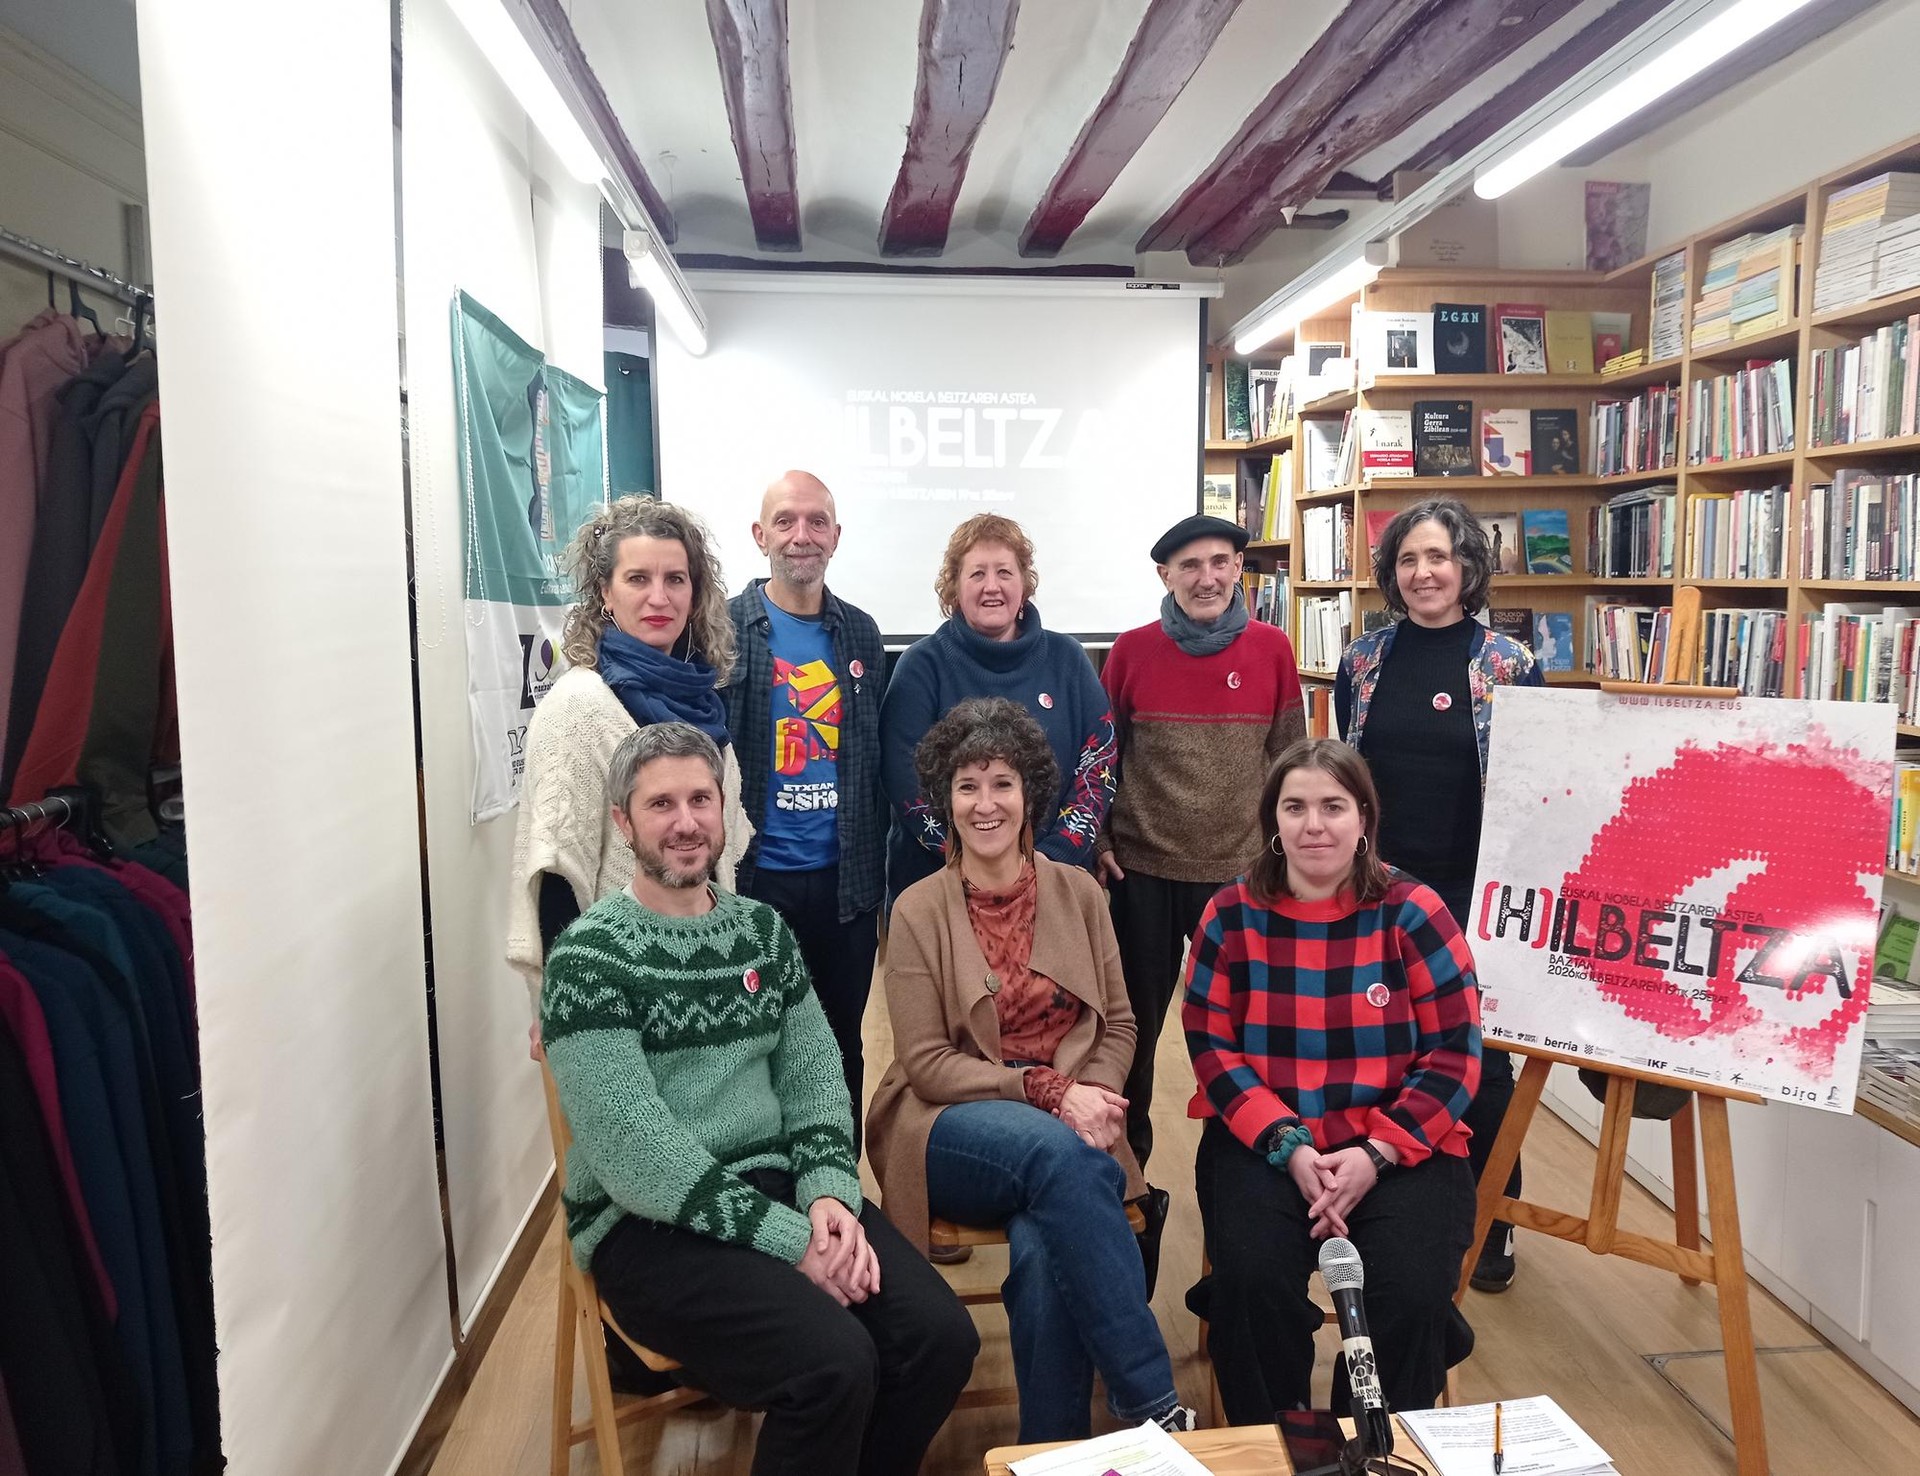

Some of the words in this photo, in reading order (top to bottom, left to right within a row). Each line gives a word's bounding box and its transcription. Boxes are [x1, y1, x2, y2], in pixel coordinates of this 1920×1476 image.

[1440, 311, 1479, 323] EGAN
[999, 392, 1037, 405] ASTEA
[1424, 412, 1449, 420] Kultura
[1423, 425, 1450, 433] Zibilean
[1619, 696, 1742, 710] WWW.ILBELTZA.EUS
[783, 782, 835, 792] ETXEAN
[1560, 887, 1601, 902] EUSKAL
[1604, 893, 1651, 908] NOBELA
[1654, 900, 1720, 917] BELTZAREN
[1724, 909, 1765, 924] ASTEA
[1478, 881, 1852, 999] (H)ILBELTZA
[1549, 954, 1596, 971] BAZTAN
[1589, 972, 1662, 993] ILBELTZAREN
[1544, 1037, 1578, 1052] berria
[1647, 1058, 1667, 1070] IKF
